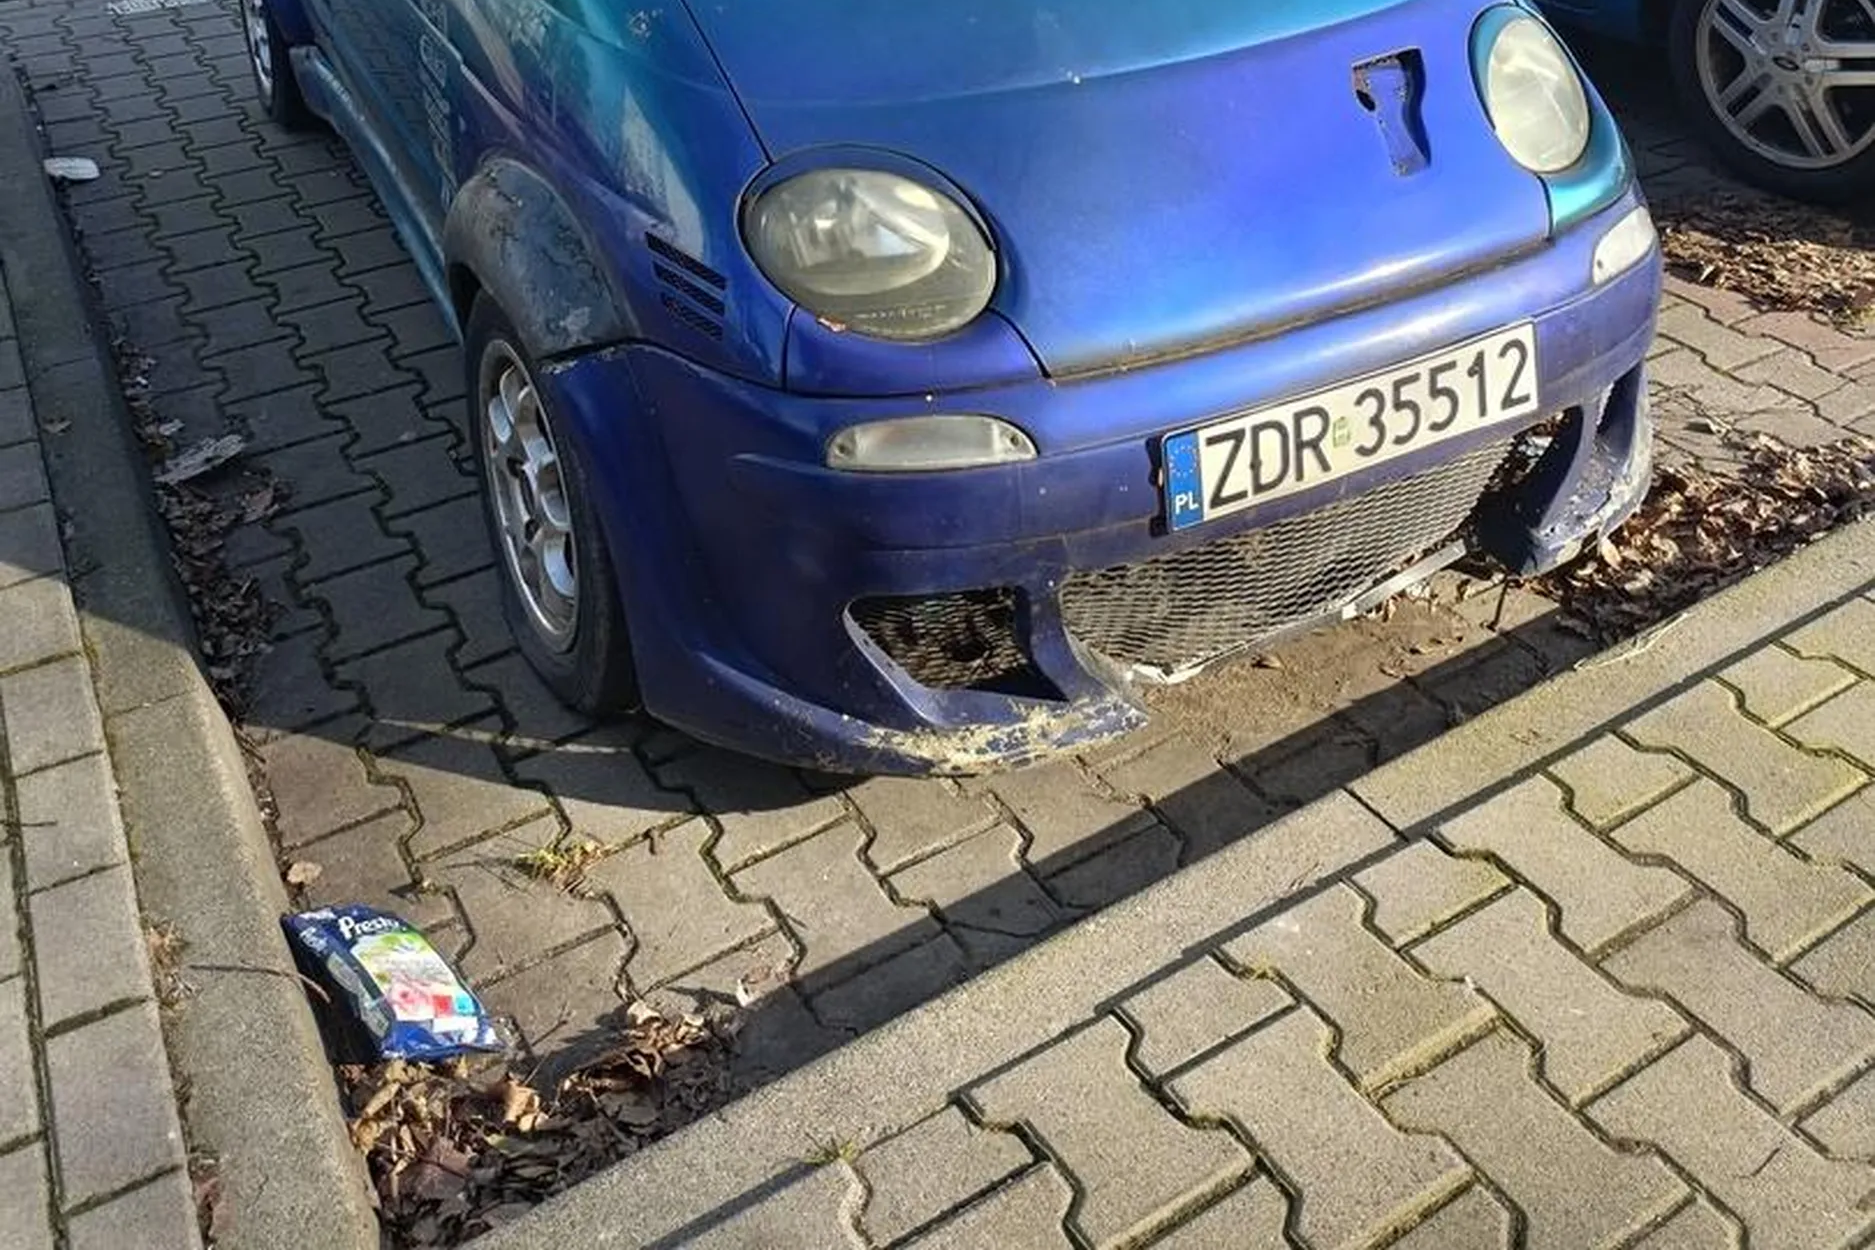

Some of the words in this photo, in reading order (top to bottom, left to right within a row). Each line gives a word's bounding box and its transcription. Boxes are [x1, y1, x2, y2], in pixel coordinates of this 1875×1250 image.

[1205, 405, 1332, 510] ZDR
[1353, 337, 1531, 457] 35512
[1174, 490, 1199, 516] PL
